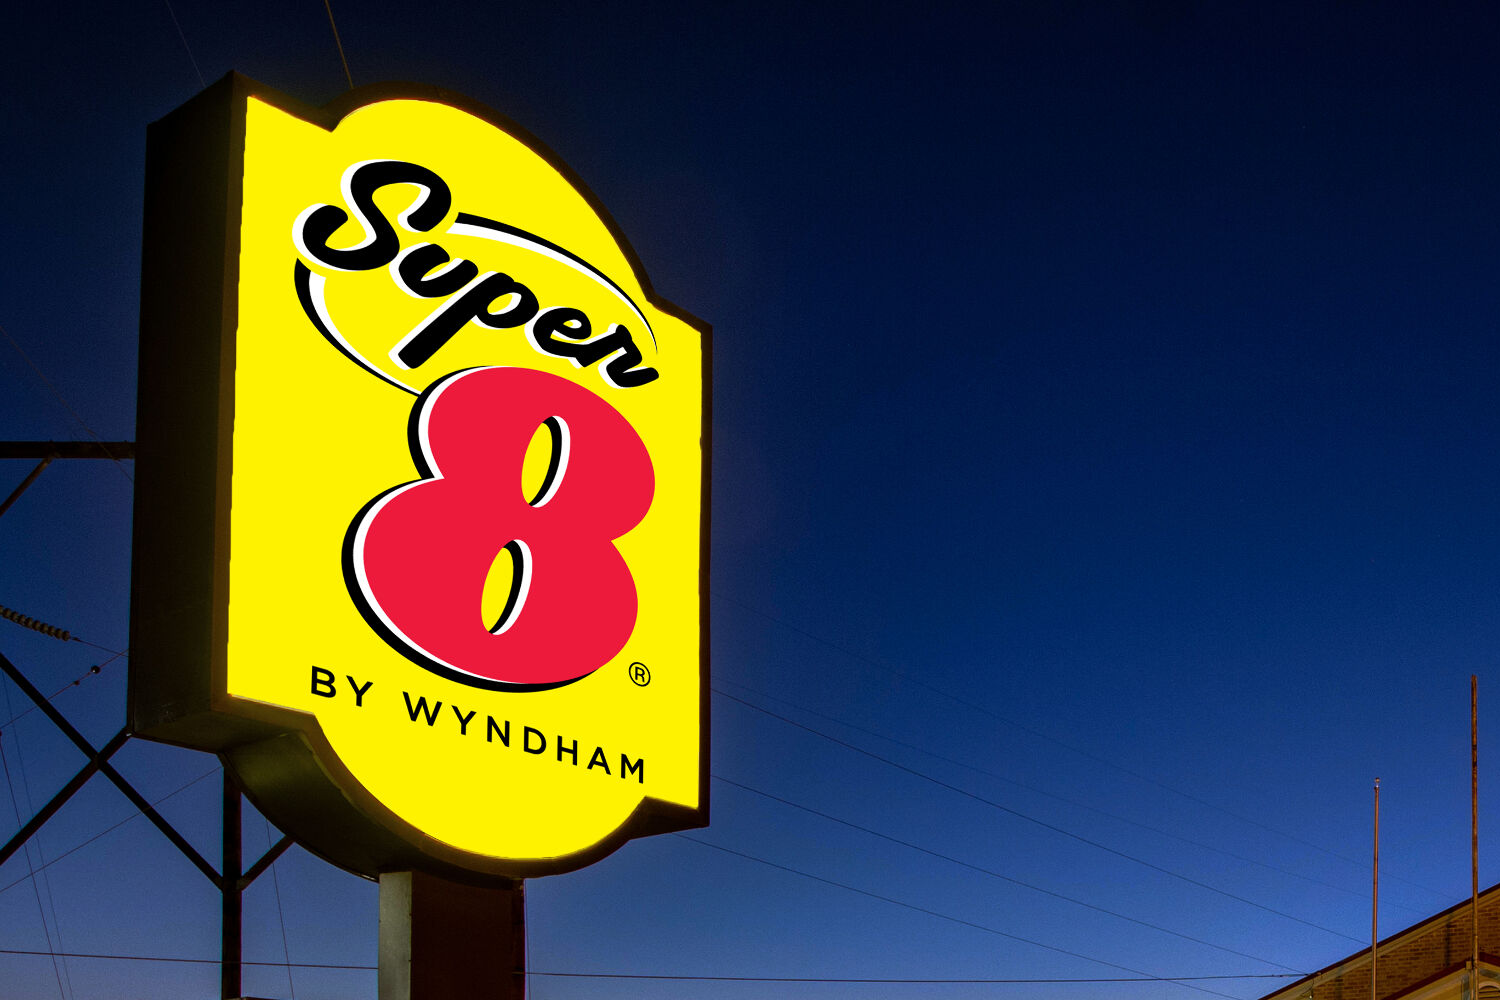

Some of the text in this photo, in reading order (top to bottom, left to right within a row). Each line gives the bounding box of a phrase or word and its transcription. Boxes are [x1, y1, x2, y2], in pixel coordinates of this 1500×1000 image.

[294, 159, 660, 389] Super
[342, 365, 656, 694] 8
[311, 665, 645, 784] BY WYNDHAM
